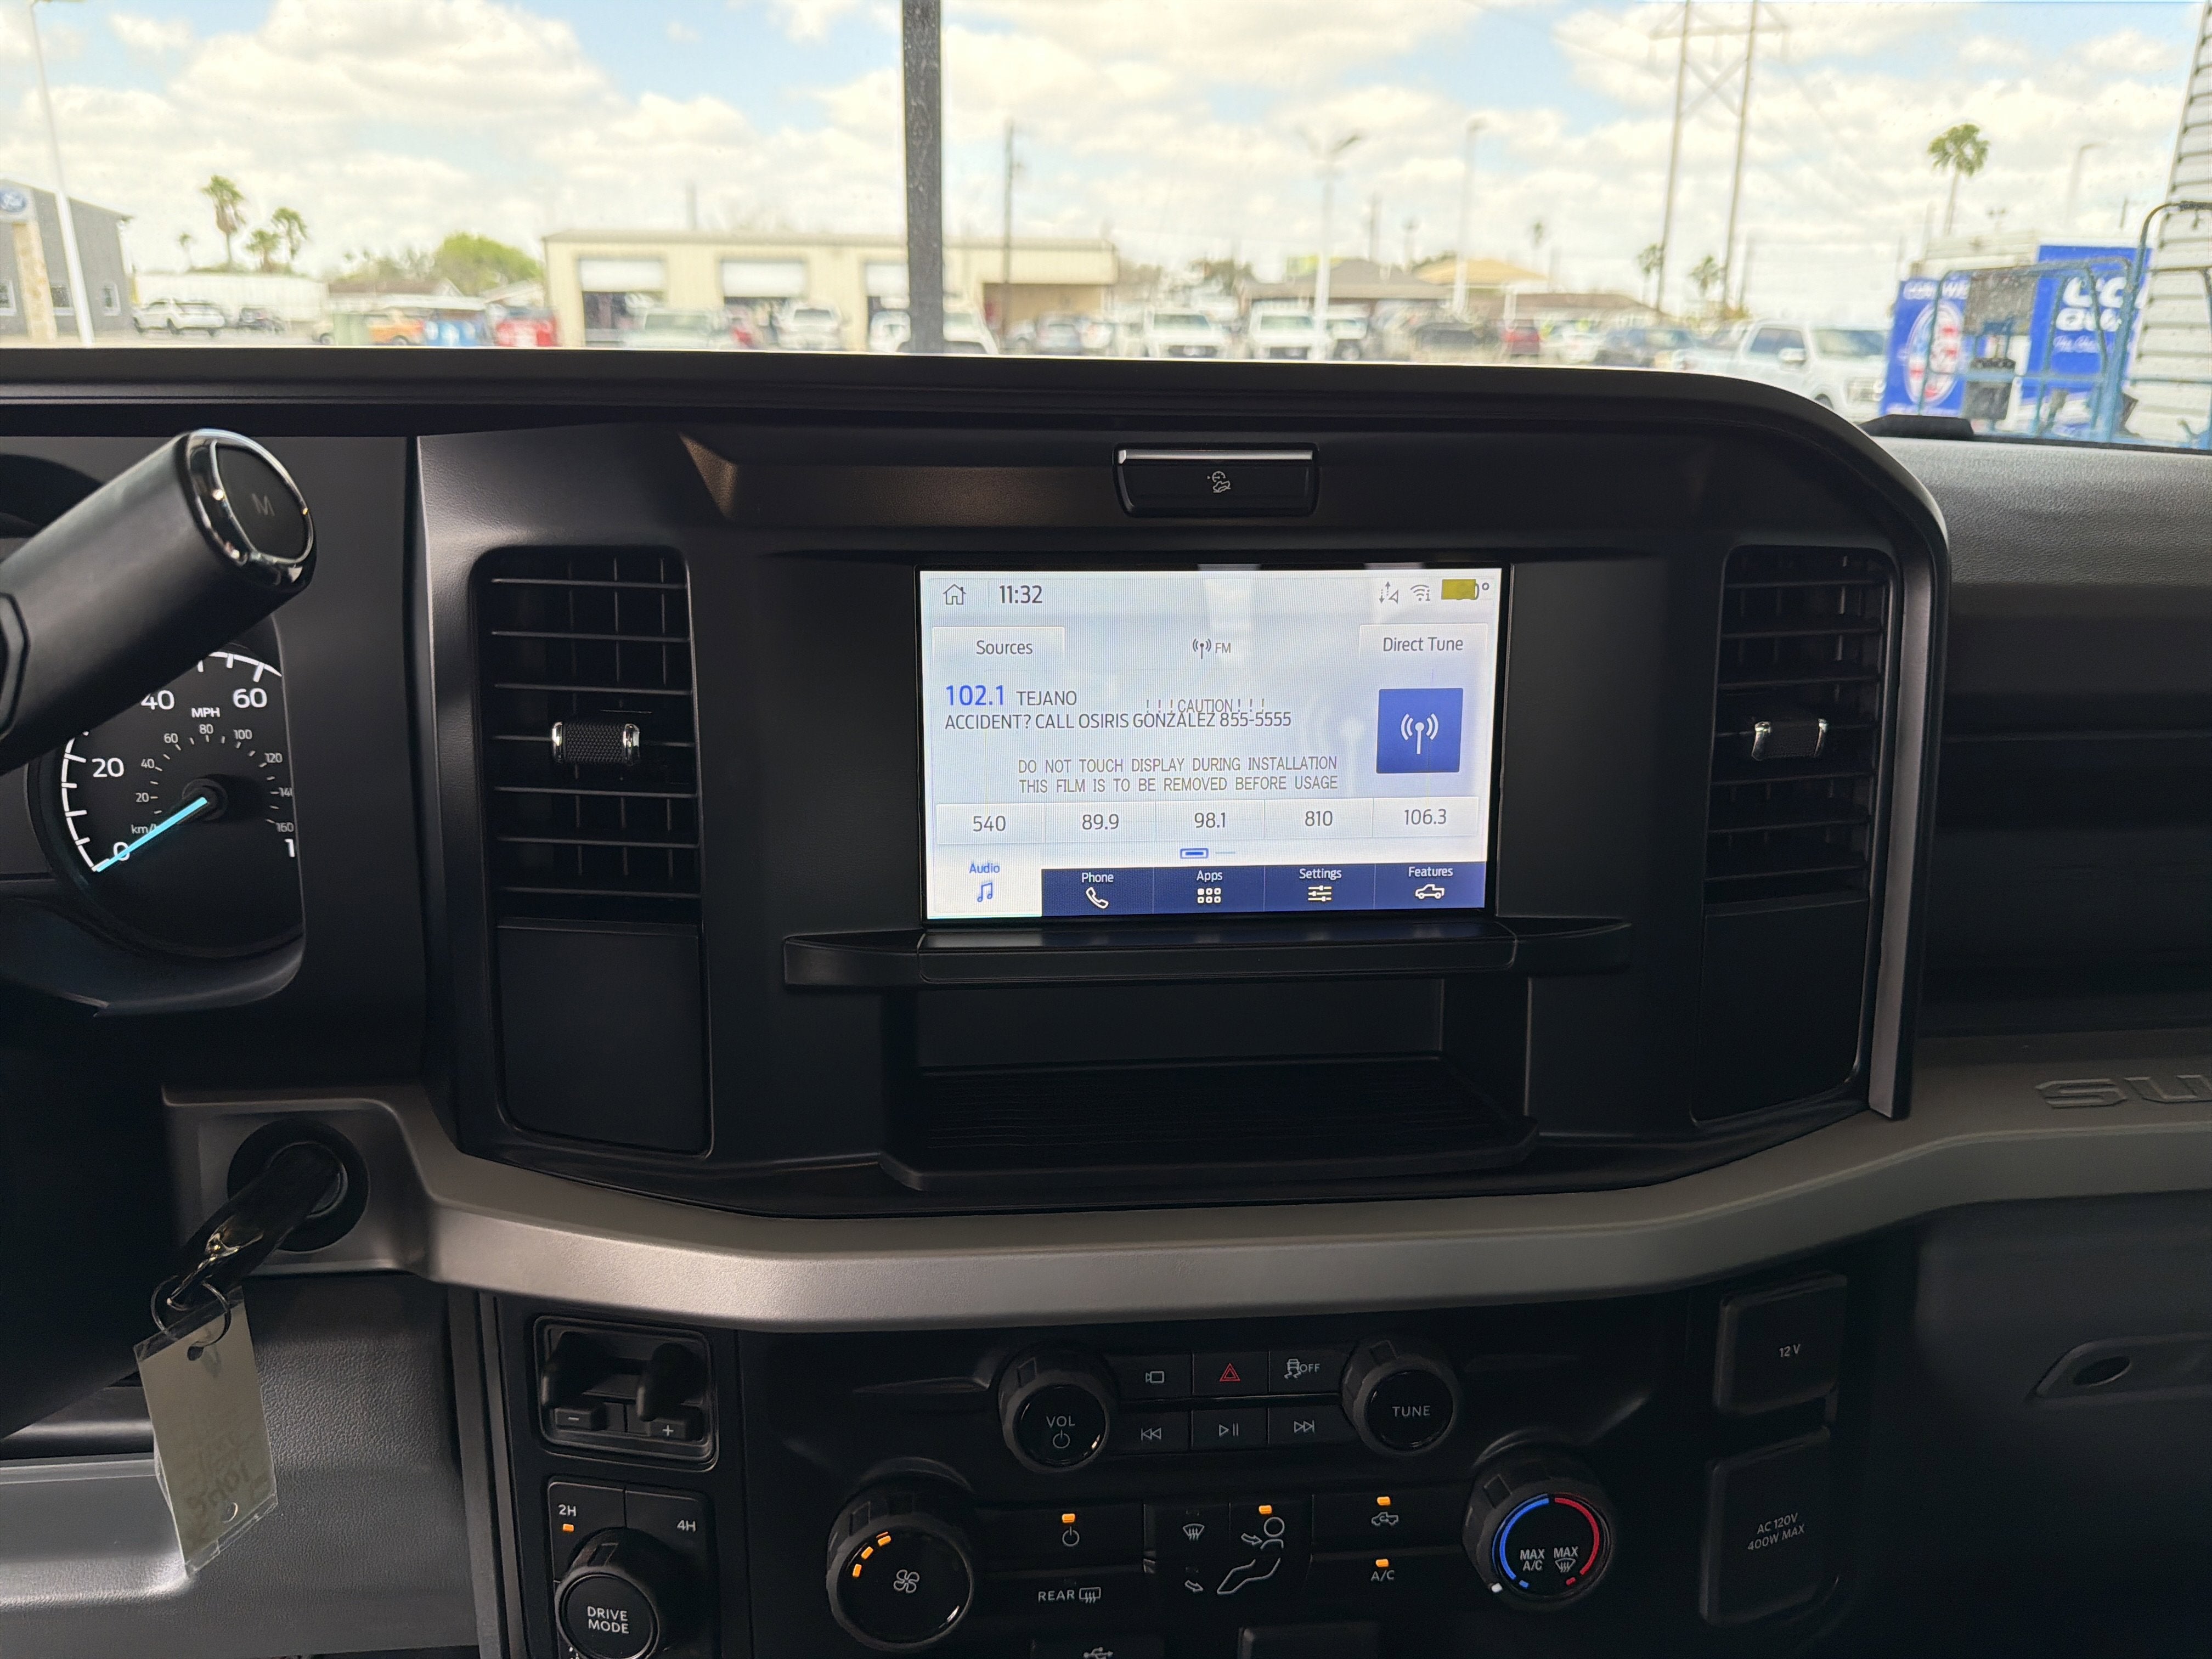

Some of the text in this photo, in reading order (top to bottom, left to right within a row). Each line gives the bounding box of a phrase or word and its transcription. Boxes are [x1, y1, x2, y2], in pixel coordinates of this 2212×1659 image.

[999, 585, 1043, 604] 11:32
[975, 640, 1034, 655] Sources
[1215, 642, 1232, 654] FM
[1383, 636, 1464, 652] Direct Tune
[141, 690, 175, 710] 40
[233, 688, 267, 709] 60
[946, 685, 1004, 706] 102.1
[1016, 690, 1077, 706] TEJANO
[191, 707, 221, 718] MPH
[945, 712, 1292, 730] ACCIDENT? CALL OSIRIS GONZALEZ 855-5555
[199, 724, 214, 735] 80
[234, 729, 252, 740] 100
[164, 733, 178, 744] 60
[140, 758, 155, 769] 40
[264, 753, 283, 763] 120
[1019, 756, 1337, 773] DO NOT TOUCH DISPLAY DURING INSTALLATION
[92, 758, 124, 777] 20
[1019, 775, 1338, 793] THIS FILM IS TO BE REMOVED BEFORE USAGE
[136, 793, 149, 803] 20
[973, 815, 1006, 832] 540
[1082, 814, 1119, 830] 89.9
[1194, 812, 1226, 828] 98.1
[1305, 810, 1333, 826] 810
[1404, 809, 1447, 825] 106.3
[276, 822, 294, 832] 160
[113, 842, 130, 861] 0
[969, 863, 1000, 874] Audio
[1299, 868, 1342, 880] Settings
[1408, 866, 1453, 877] Features
[1081, 872, 1114, 883] Phone
[1197, 870, 1223, 882] Apps
[1300, 1363, 1321, 1373] OFF
[1392, 1405, 1431, 1418] TUNE
[1046, 1415, 1076, 1427] VOL
[558, 1504, 577, 1517] 2H
[676, 1520, 696, 1532] 4H
[1757, 1512, 1798, 1534] AC 120V
[1747, 1523, 1805, 1550] 400W MAX
[1520, 1548, 1545, 1560] MAX
[1554, 1546, 1579, 1558] MAX
[1522, 1559, 1543, 1571] A/C
[1372, 1570, 1395, 1582] A/C
[1038, 1590, 1075, 1602] REAR
[586, 1606, 628, 1622] DRIVE
[588, 1618, 629, 1634] MODE
